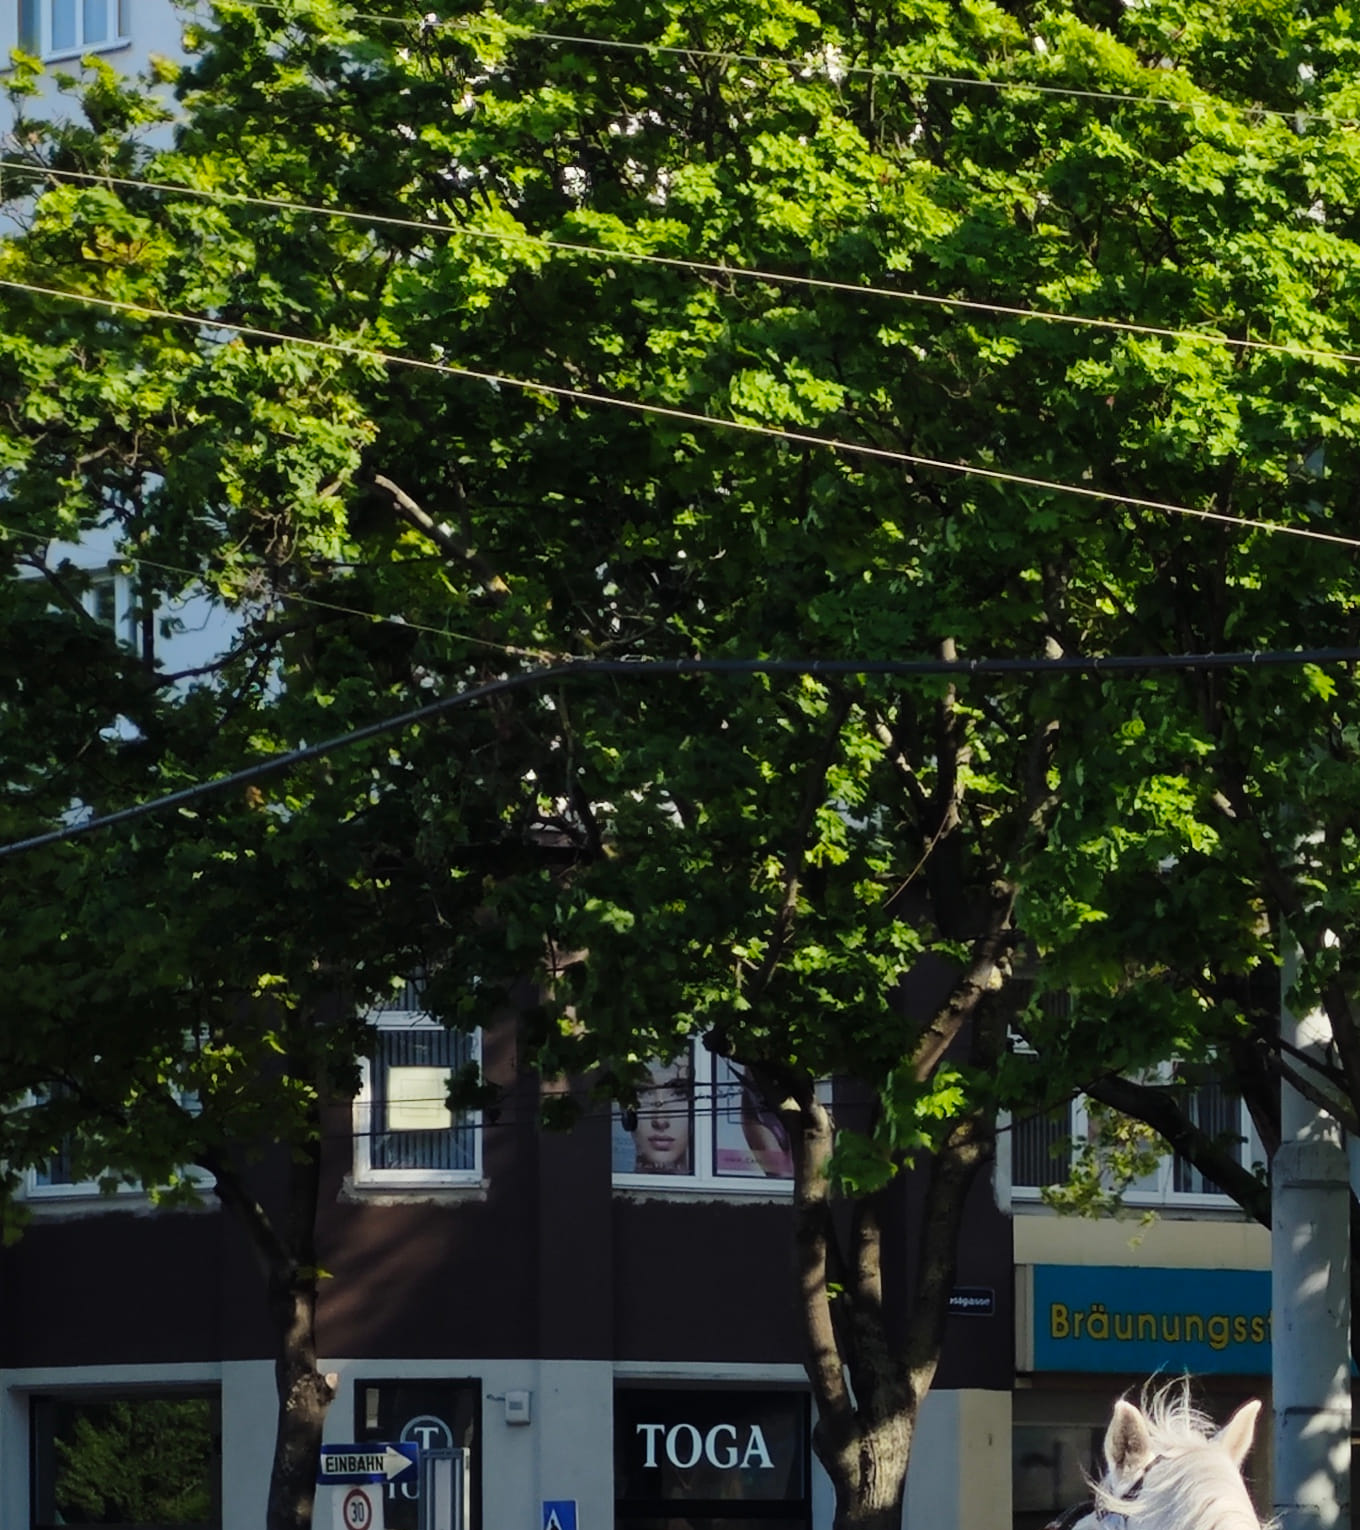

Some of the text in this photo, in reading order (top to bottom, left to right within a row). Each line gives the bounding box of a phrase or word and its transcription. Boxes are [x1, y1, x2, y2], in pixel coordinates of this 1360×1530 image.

[636, 1423, 776, 1469] TOGA
[325, 1456, 384, 1473] EINBAHN
[350, 1502, 365, 1523] 30
